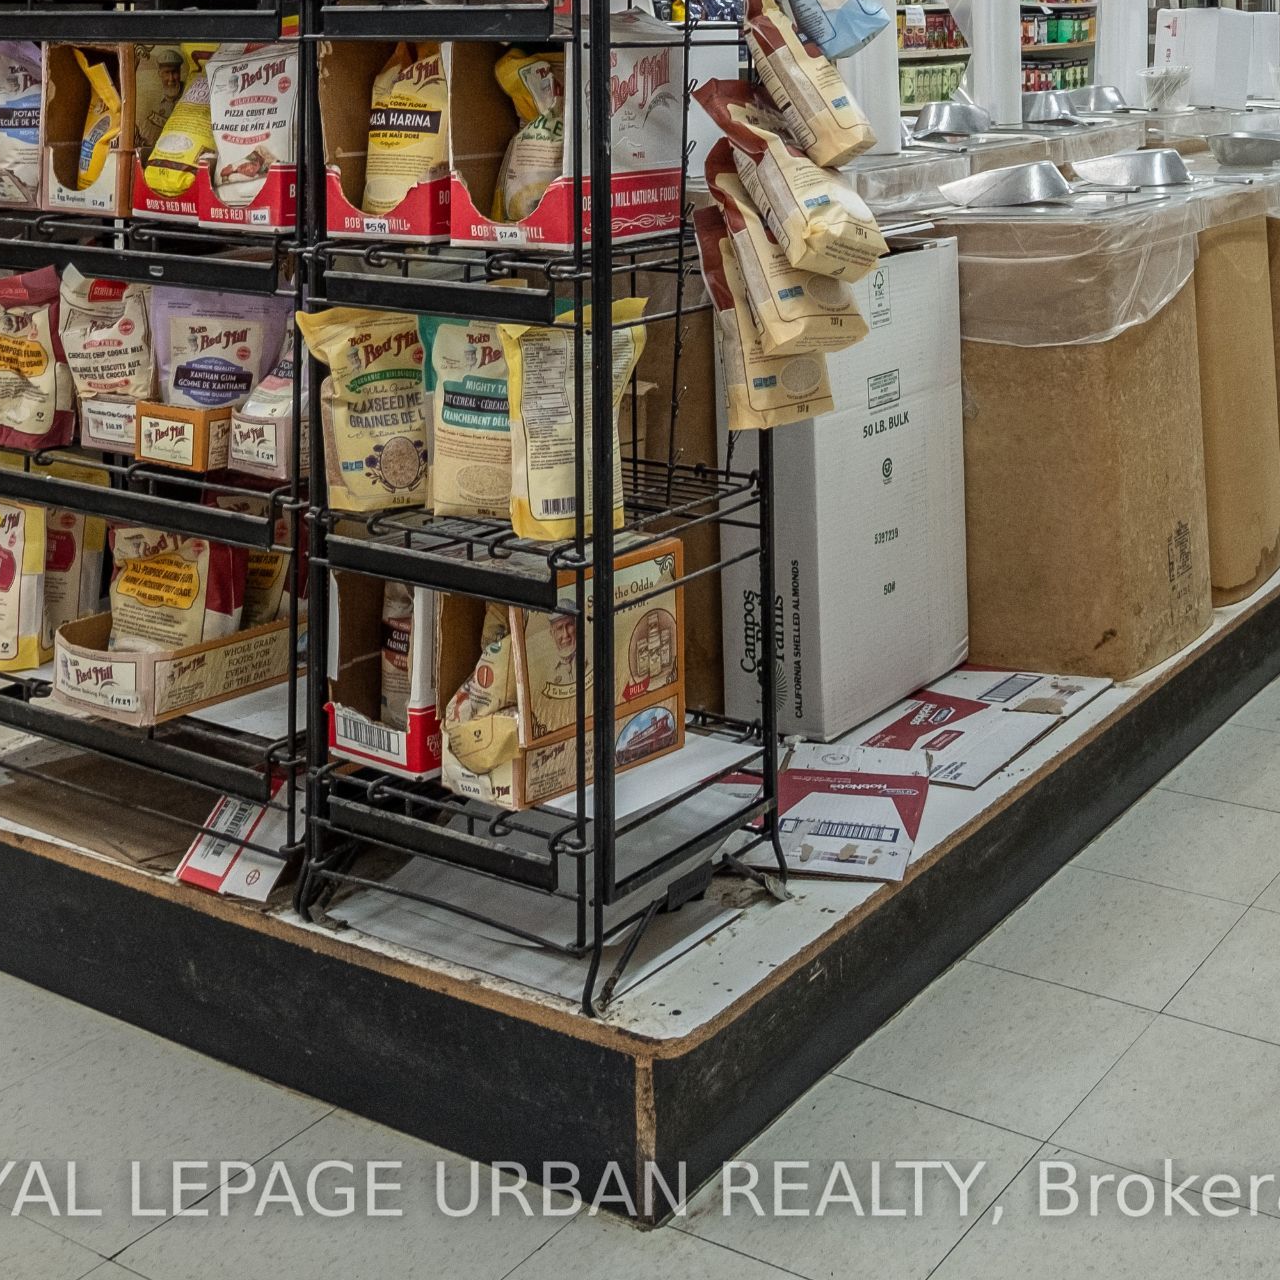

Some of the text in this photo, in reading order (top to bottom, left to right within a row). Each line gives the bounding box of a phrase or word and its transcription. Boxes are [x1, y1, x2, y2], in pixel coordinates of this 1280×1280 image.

[239, 58, 287, 94] Red Mill
[414, 56, 439, 86] Mill
[609, 46, 671, 119] Red Mill
[389, 100, 407, 108] CORN
[224, 108, 266, 118] PIZZA CRUST
[388, 111, 432, 129] HARINA
[240, 121, 265, 132] DE PÂTE
[57, 194, 66, 202] Egg
[615, 186, 680, 208] MILL NATURAL FOODS
[146, 199, 197, 214] BOB'S RED MILL
[210, 207, 244, 221] BOB'S RED
[855, 227, 864, 236] 737
[830, 316, 839, 326] 737
[200, 327, 249, 352] Red Mill
[93, 347, 129, 359] CHIP COOKIE
[363, 336, 392, 369] Red
[99, 360, 141, 372] BISCUITS AUX
[178, 379, 247, 391] GOMME DE XANTHANE
[189, 371, 237, 382] XANTHAN GUM
[465, 380, 496, 393] MIGHTY
[348, 393, 406, 415] FLAXSEED
[452, 394, 477, 407] CEREAL
[797, 403, 806, 413] 737
[349, 411, 414, 430] GRAINES DE
[443, 409, 492, 426] FRANCHEMENT
[862, 411, 910, 439] 50 LB. BULK
[154, 425, 185, 442] Red Mill
[238, 426, 265, 442] Red Mill
[614, 578, 655, 600] the Odds
[739, 588, 757, 675] Campos
[790, 559, 803, 718] CALIFORNIA SHELLED ALMONDS
[223, 636, 277, 657] WHOLE GRAIN
[228, 649, 271, 667] FOODS FOR
[75, 665, 114, 686] Red Mill
[225, 659, 272, 680] EVERY MEAL
[222, 676, 252, 690] OF THE
[629, 682, 647, 696] PULL
